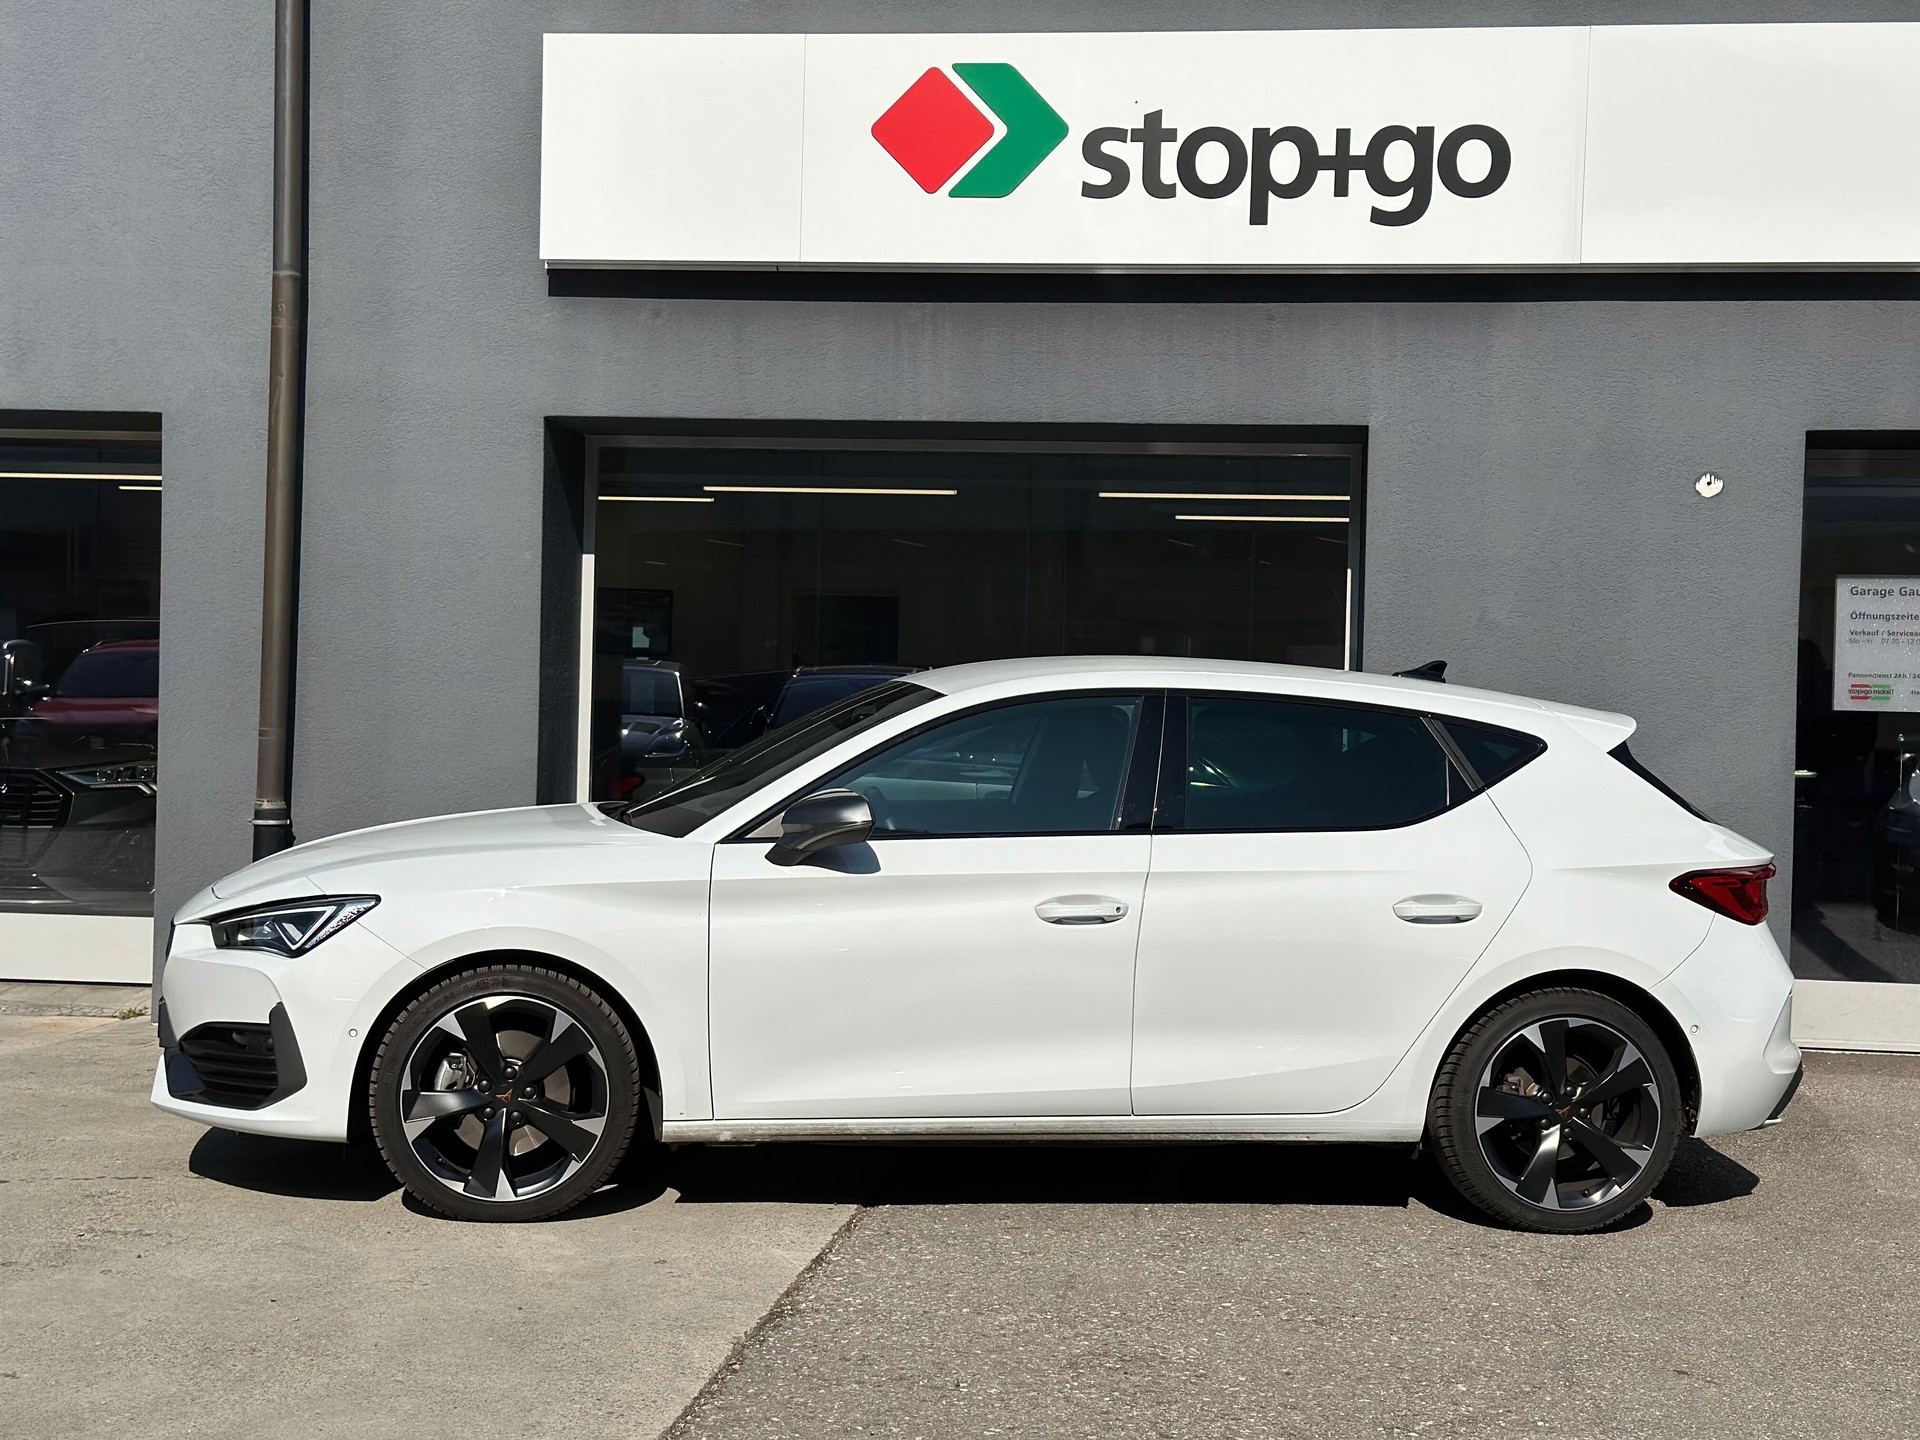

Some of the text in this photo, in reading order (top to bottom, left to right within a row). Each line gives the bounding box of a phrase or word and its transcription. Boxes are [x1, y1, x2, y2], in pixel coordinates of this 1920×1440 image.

[1081, 109, 1511, 226] stop+go
[1850, 586, 1895, 599] Garage
[1850, 610, 1920, 622] Öffnungszeite
